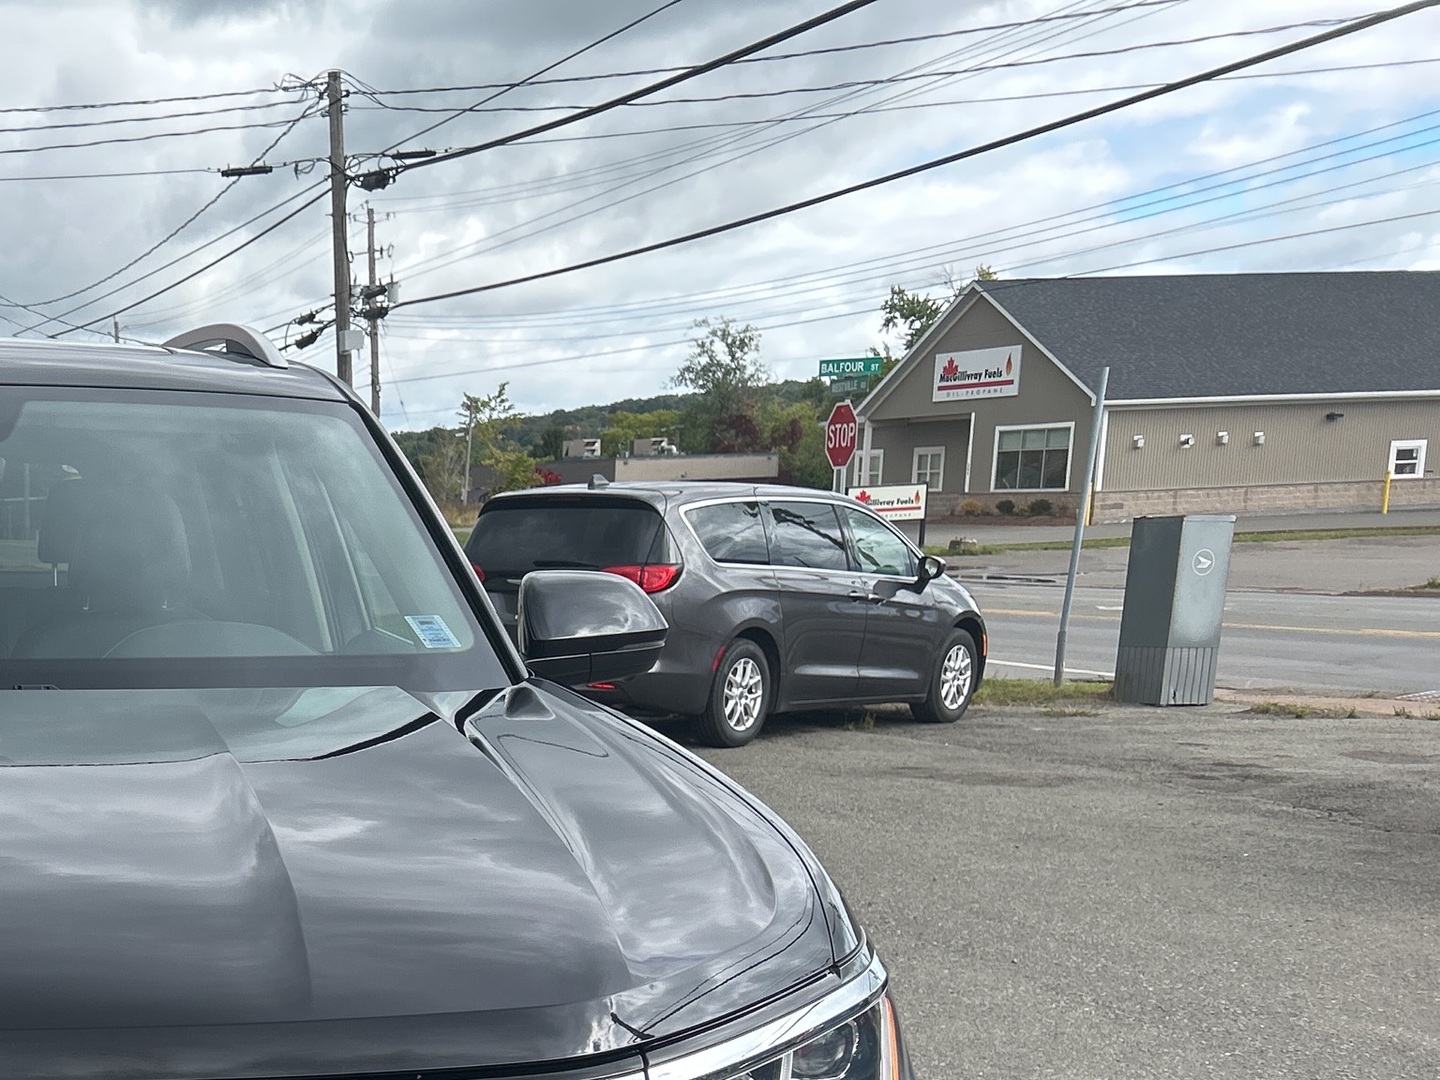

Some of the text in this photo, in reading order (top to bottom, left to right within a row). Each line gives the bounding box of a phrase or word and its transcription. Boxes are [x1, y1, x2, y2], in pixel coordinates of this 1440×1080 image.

[821, 362, 879, 374] BALFOUR ST
[984, 367, 1003, 379] Fuels
[828, 423, 855, 449] STOP
[896, 497, 914, 505] Fuels
